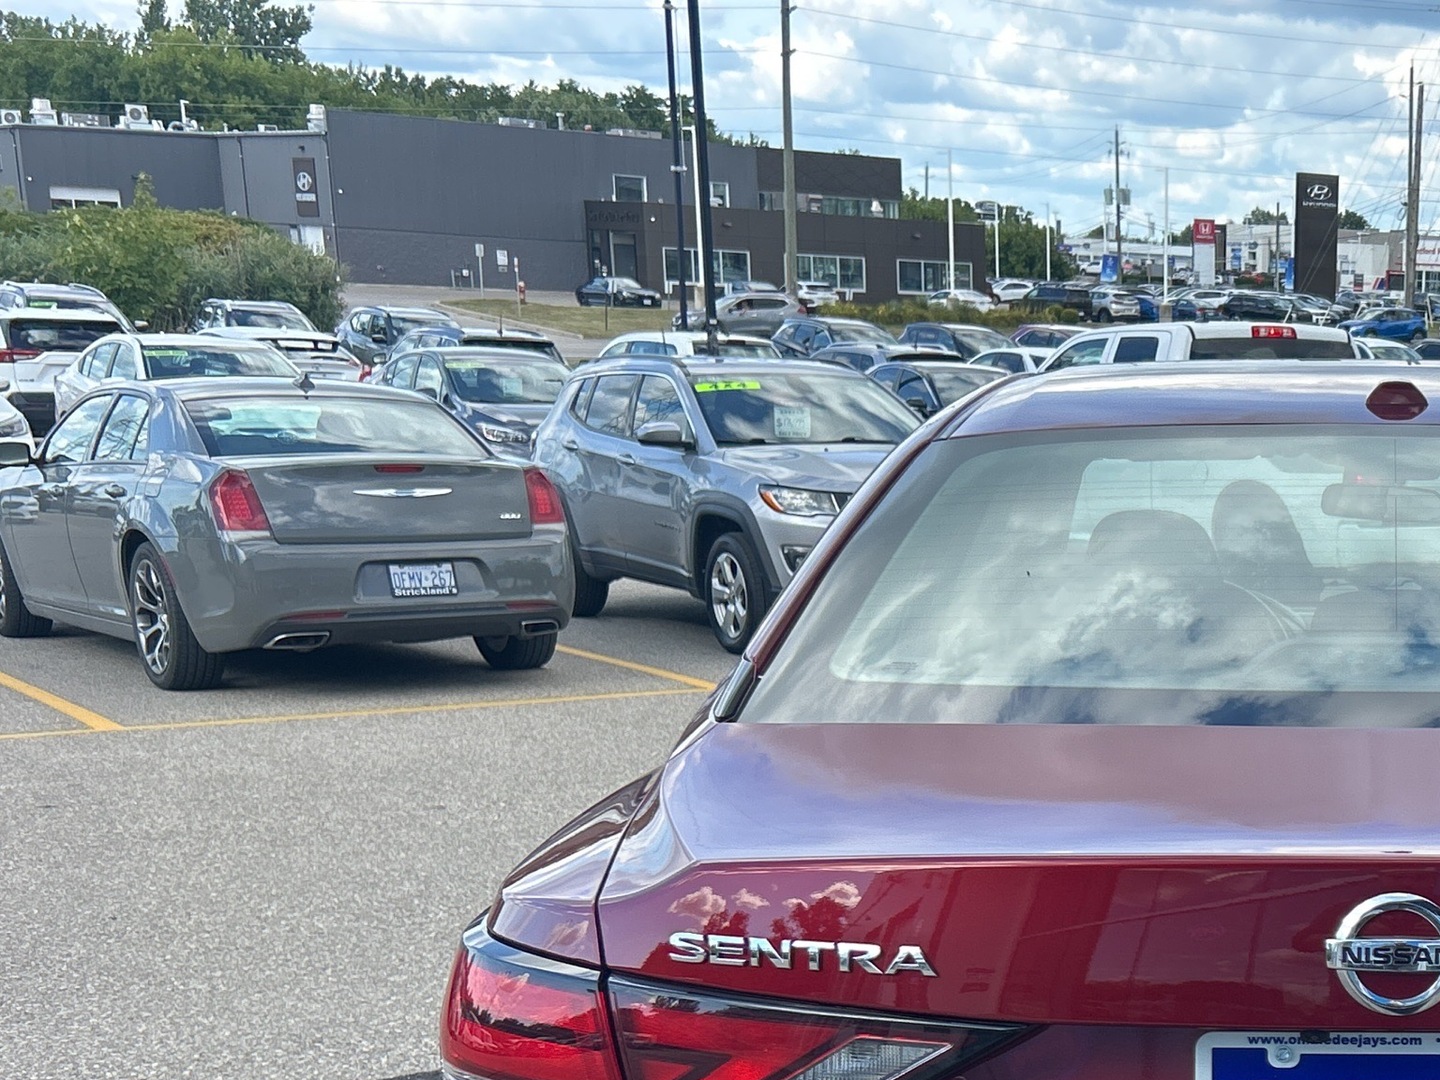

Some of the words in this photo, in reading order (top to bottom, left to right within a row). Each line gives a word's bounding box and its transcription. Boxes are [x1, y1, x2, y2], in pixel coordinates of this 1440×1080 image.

[431, 570, 452, 587] 267
[394, 587, 458, 597] Strickland's
[669, 932, 938, 977] SENTRA
